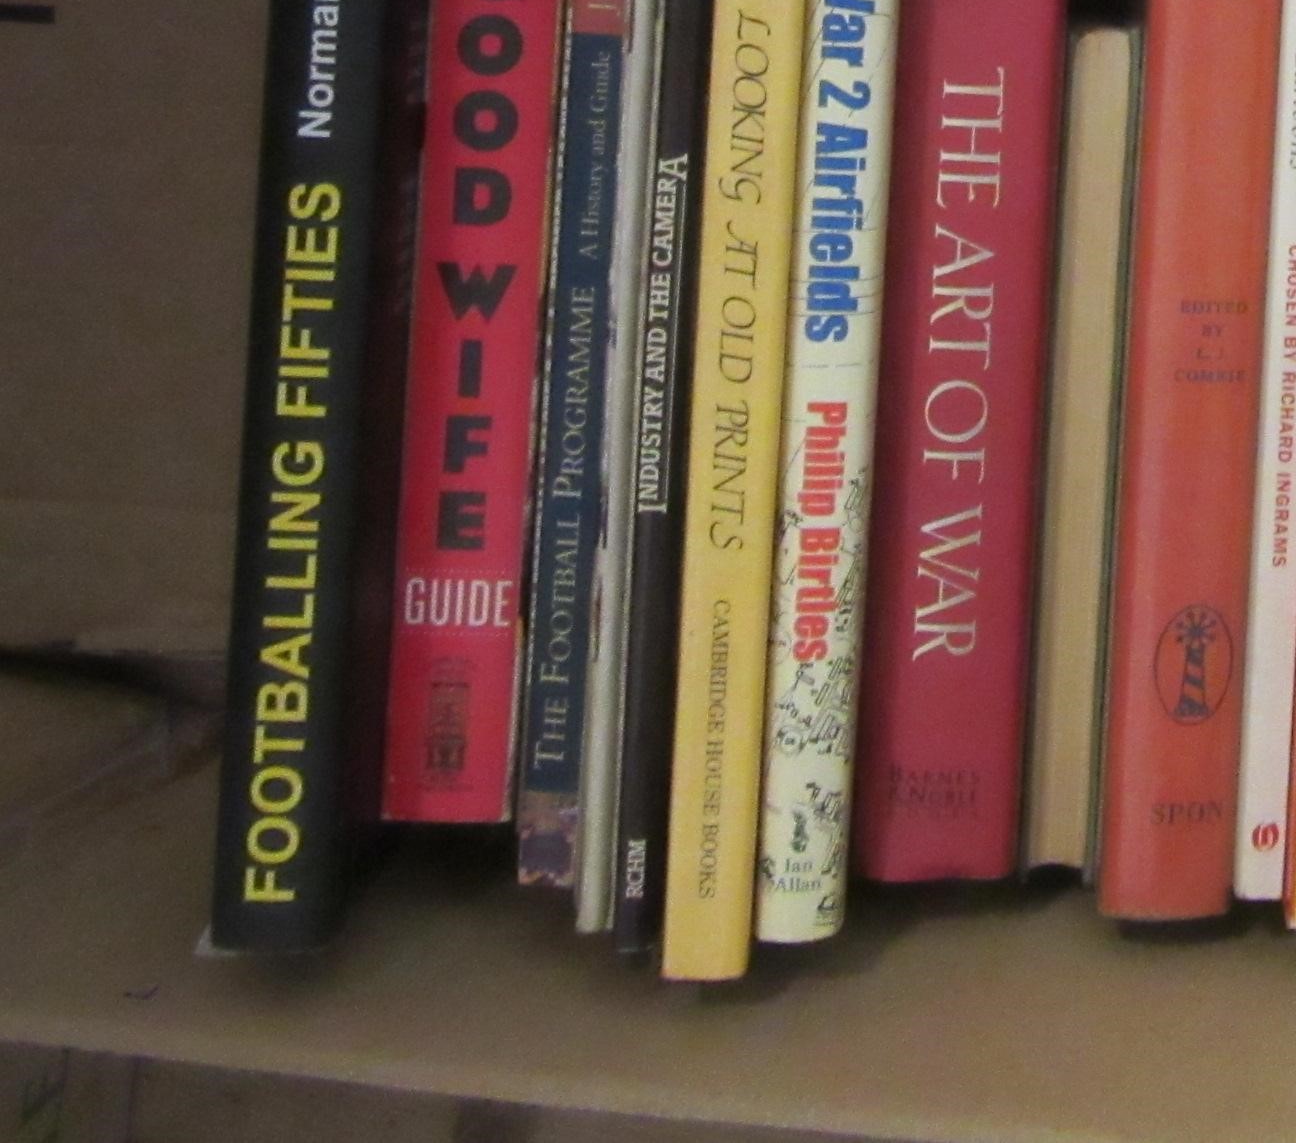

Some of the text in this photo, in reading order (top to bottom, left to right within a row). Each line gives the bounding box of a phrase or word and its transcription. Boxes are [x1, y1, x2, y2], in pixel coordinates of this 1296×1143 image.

[588, 119, 607, 155] and
[818, 79, 871, 110] 2
[580, 163, 609, 236] History
[708, 8, 771, 550] LOOKING AT OLD PRINTS
[804, 122, 869, 343] Airfields
[436, 262, 518, 550] WIFE
[552, 286, 595, 500] PROGRAMME
[638, 153, 687, 512] INDUSTRY AND THE CAMERA
[912, 66, 1005, 662] THE ART OF WAR
[1278, 372, 1296, 463] RICHARD
[243, 182, 342, 903] FOOTBALLING FIFTIES
[404, 577, 513, 627] GUIDE
[540, 511, 580, 684] FOOTBALL
[792, 401, 848, 662] Philip Birtles
[1272, 473, 1290, 568] INGRAMS
[534, 696, 569, 770] THE
[699, 599, 730, 900] CAMBRIDGE HOUSE BOOKS
[1151, 801, 1223, 826] SPON
